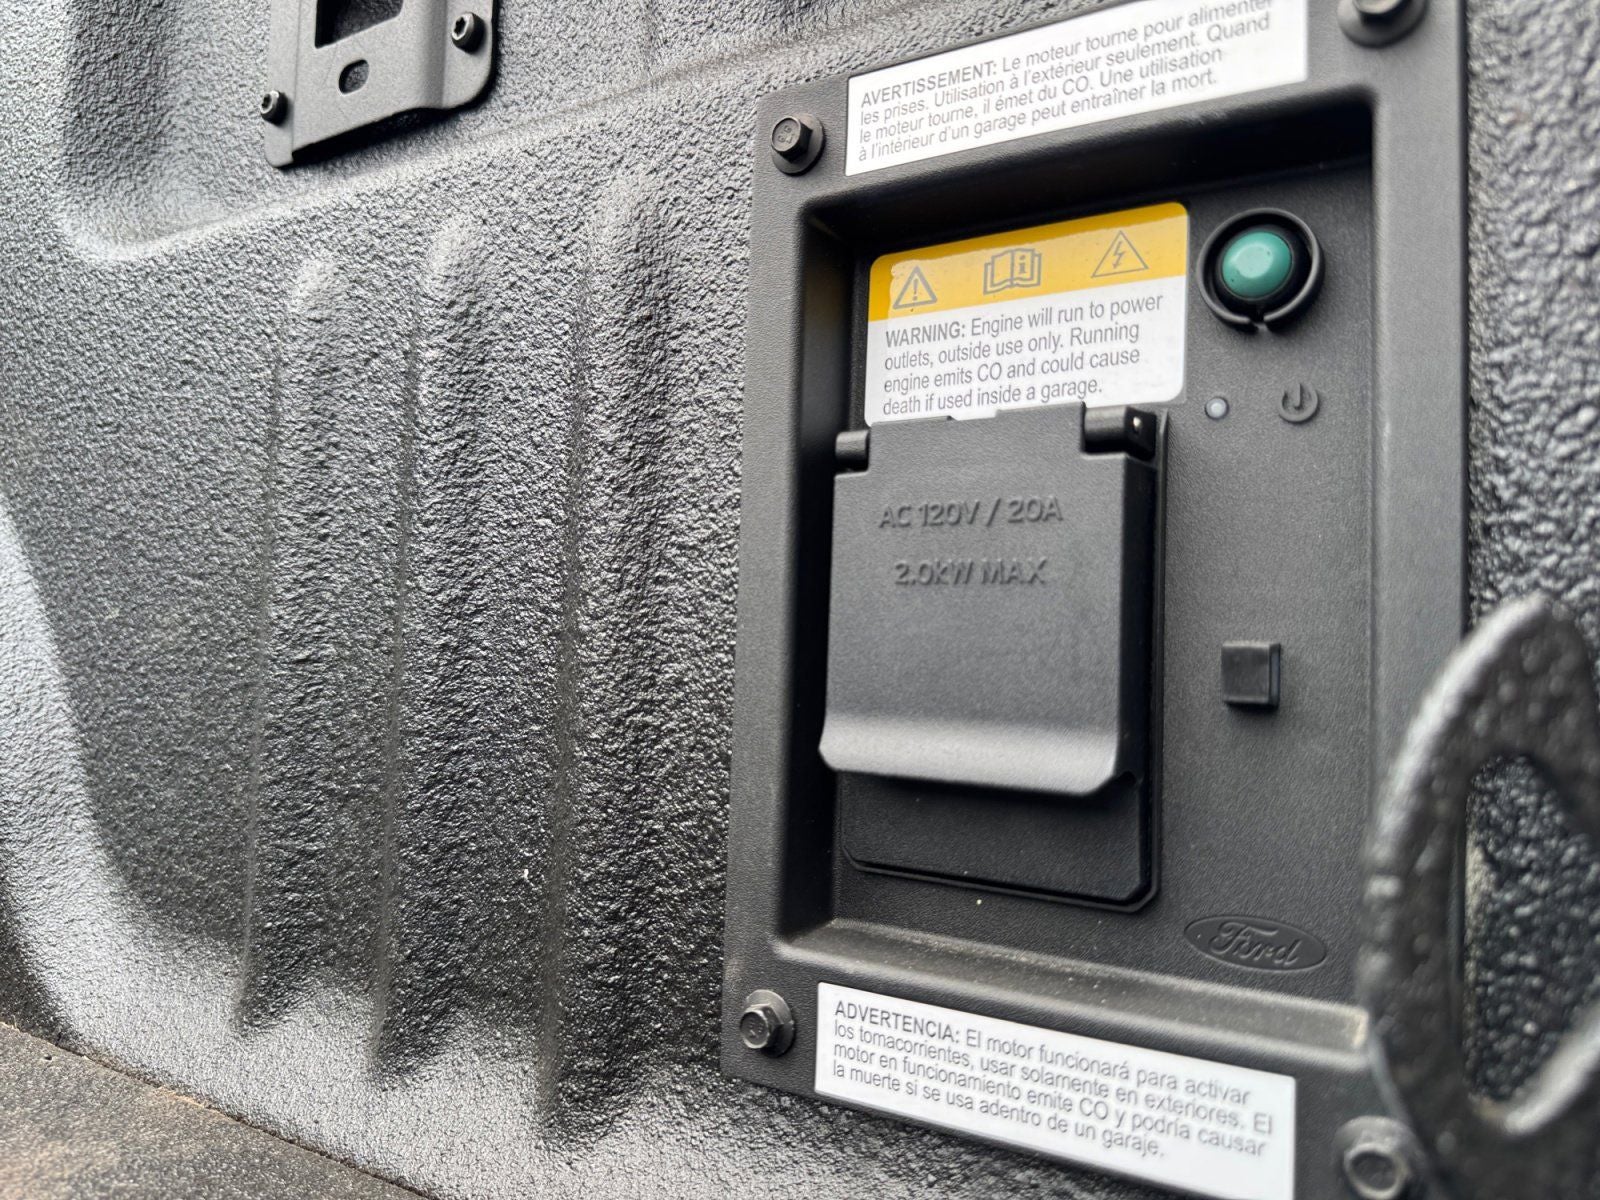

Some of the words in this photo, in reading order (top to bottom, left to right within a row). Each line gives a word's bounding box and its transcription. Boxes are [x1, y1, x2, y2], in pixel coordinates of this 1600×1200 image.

[859, 129, 871, 144] le
[876, 117, 924, 140] moteur
[928, 106, 978, 127] tourne,
[983, 100, 990, 114] il
[995, 91, 1034, 112] émet
[1038, 85, 1057, 102] du
[1063, 75, 1094, 96] CO.
[1100, 69, 1134, 87] Une
[1139, 48, 1223, 79] utilisation
[861, 61, 997, 108] AVERTISSEMENT:
[1002, 57, 1021, 73] Le
[1026, 42, 1081, 67] moteur
[1086, 27, 1138, 51] tourne
[1143, 16, 1182, 41] pour
[861, 111, 879, 126] les
[884, 100, 929, 120] prises.
[934, 79, 1004, 107] Utilisation
[1009, 75, 1019, 89] à
[1024, 57, 1101, 86] l'extérieur
[1106, 31, 1200, 66] seulement.
[1207, 11, 1270, 42] Quand
[858, 147, 867, 162] à
[871, 132, 935, 159] l'intérieur
[938, 122, 969, 143] d'un
[974, 112, 1026, 139] garage
[1031, 101, 1066, 126] peut
[1071, 84, 1146, 113] entraîner
[1151, 80, 1165, 97] la
[1172, 69, 1218, 92] mort.
[885, 350, 934, 370] outlets,
[939, 341, 991, 364] outside
[996, 339, 1023, 357] use
[1028, 331, 1064, 354] only.
[1070, 322, 1140, 347] Running
[886, 321, 966, 348] WARNING:
[971, 314, 1023, 338] Engine
[1028, 307, 1053, 328] will
[1058, 306, 1084, 324] run
[1089, 301, 1104, 319] to
[1110, 295, 1163, 321] power
[883, 395, 921, 416] death
[925, 393, 935, 412] if
[937, 389, 973, 410] used
[977, 385, 1022, 406] inside
[1026, 386, 1036, 401] a
[1041, 378, 1103, 404] garage.
[884, 373, 930, 396] engine
[934, 367, 973, 387] emits
[977, 362, 1002, 382] CO
[1007, 358, 1036, 379] and
[1041, 351, 1085, 375] could
[1089, 348, 1140, 368] cause
[878, 505, 912, 529] AC
[918, 500, 981, 528] 120V
[985, 497, 1002, 528] /
[1007, 495, 1064, 524] 20A
[894, 558, 975, 586] 2.0kW
[981, 558, 1048, 585] MAX
[1208, 921, 1303, 967] Ford
[834, 1000, 960, 1044] ADVERTENCIA:
[966, 1028, 981, 1049] El
[986, 1037, 1034, 1059] motor
[1039, 1043, 1130, 1081] funcionará
[1137, 1068, 1178, 1090] para
[1185, 1078, 1251, 1105] activar
[834, 1020, 854, 1040] los
[859, 1026, 974, 1070] tomacorrientes,
[980, 1057, 1016, 1078] usar
[1021, 1066, 1109, 1099] solamente
[1116, 1088, 1137, 1105] en
[1145, 1093, 1245, 1129] exteriores.
[1253, 1111, 1273, 1135] El
[833, 1060, 845, 1077] la
[850, 1066, 901, 1091] muerte
[906, 1080, 918, 1096] si
[923, 1085, 941, 1102] se
[946, 1091, 974, 1110] usa
[979, 1100, 1041, 1127] adentro
[1047, 1114, 1068, 1133] de
[1075, 1122, 1096, 1141] un
[1102, 1127, 1164, 1158] garaje.
[834, 1043, 875, 1064] motor
[879, 1055, 897, 1070] en
[903, 1057, 1021, 1100] funcionamiento
[1027, 1089, 1073, 1112] emite
[1079, 1097, 1109, 1120] CO
[1115, 1109, 1125, 1128] y
[1132, 1112, 1191, 1140] podría
[1198, 1127, 1266, 1156] causar
